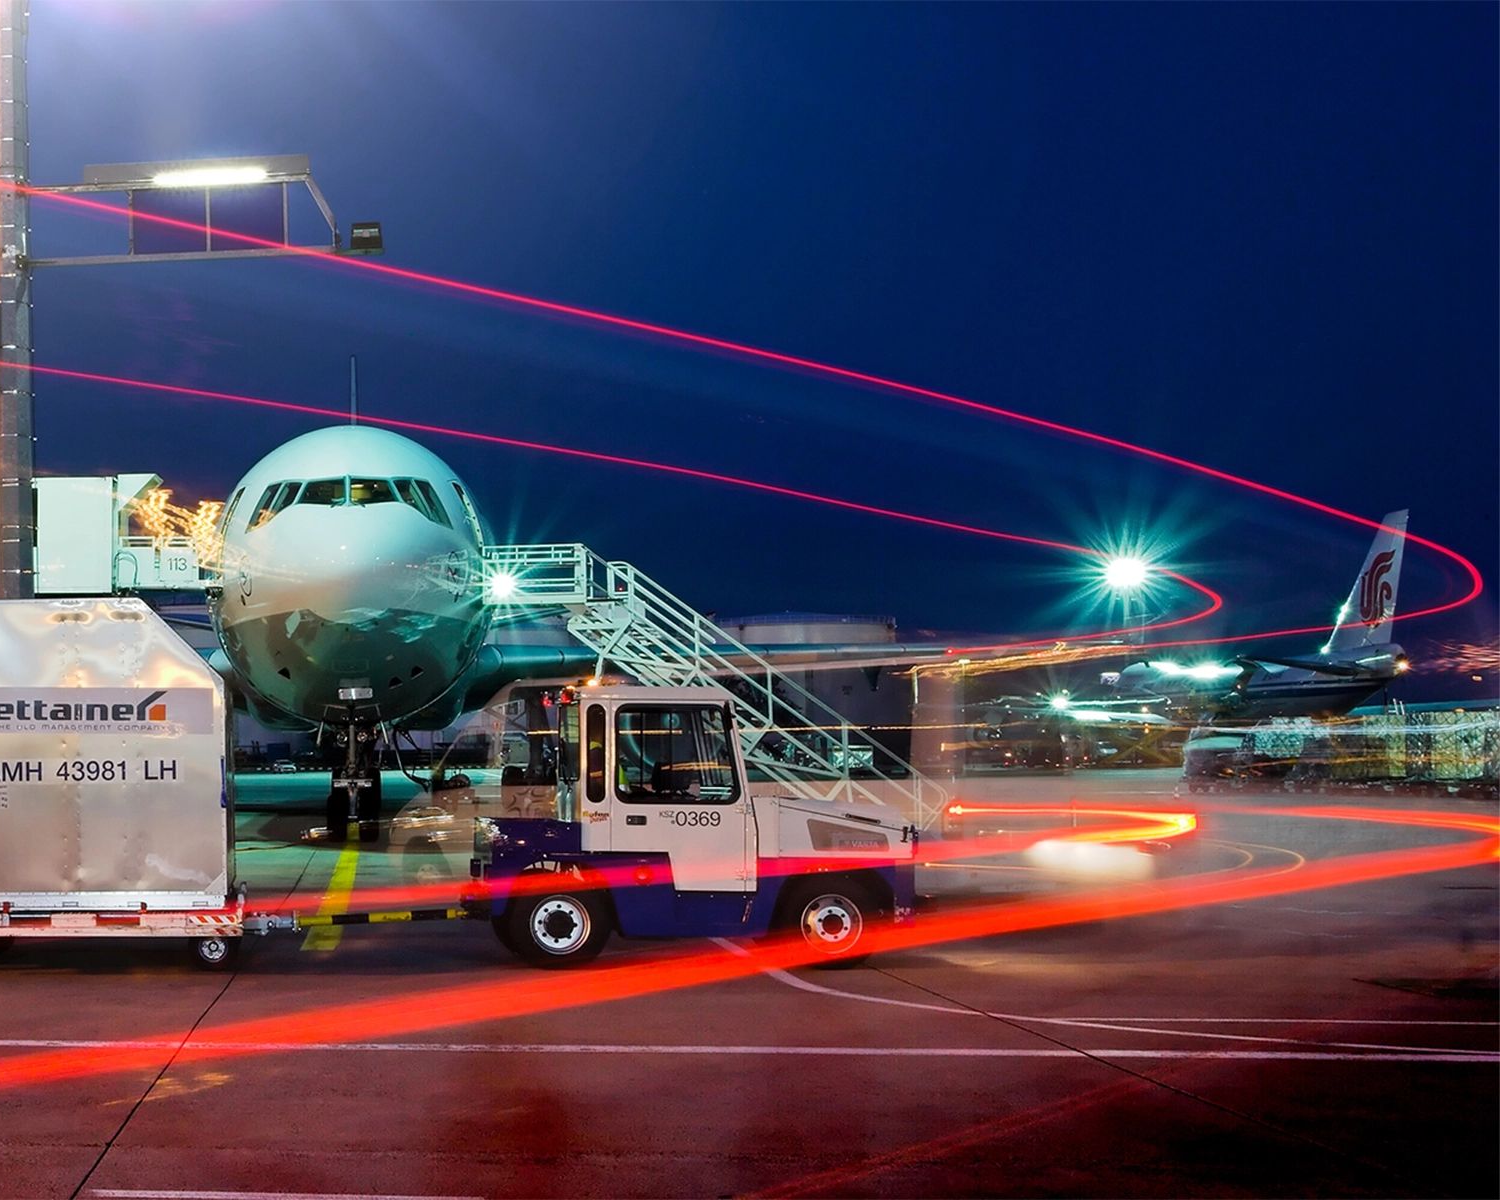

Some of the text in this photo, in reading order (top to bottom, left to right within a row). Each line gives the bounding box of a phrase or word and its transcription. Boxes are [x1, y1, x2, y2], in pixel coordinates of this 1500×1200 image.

[168, 557, 187, 571] 113
[56, 760, 127, 781] 43981
[144, 760, 177, 780] LH
[675, 811, 721, 826] 0369
